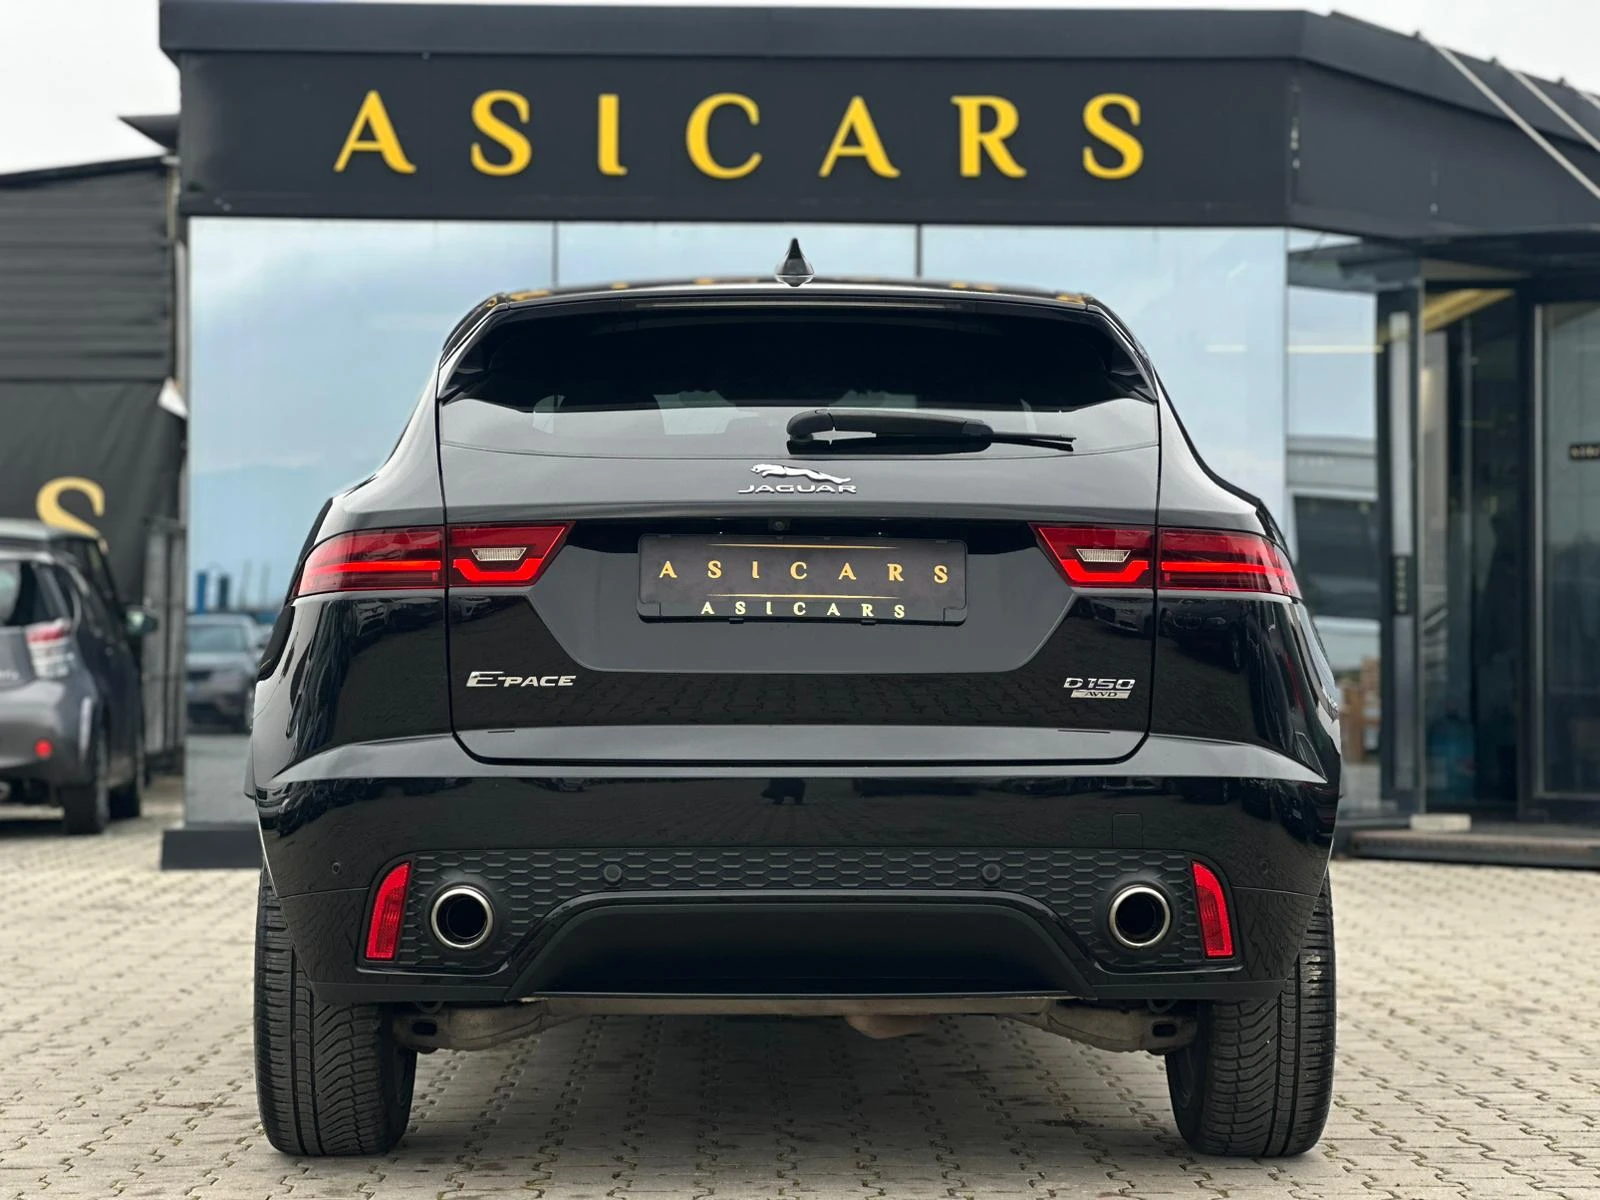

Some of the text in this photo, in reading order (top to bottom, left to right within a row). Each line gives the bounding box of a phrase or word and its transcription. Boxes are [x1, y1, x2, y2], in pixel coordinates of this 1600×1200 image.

[334, 89, 1146, 181] ASICARS
[738, 484, 857, 494] JAGUAR
[658, 560, 950, 584] ASICARS
[700, 601, 905, 619] ASICARS
